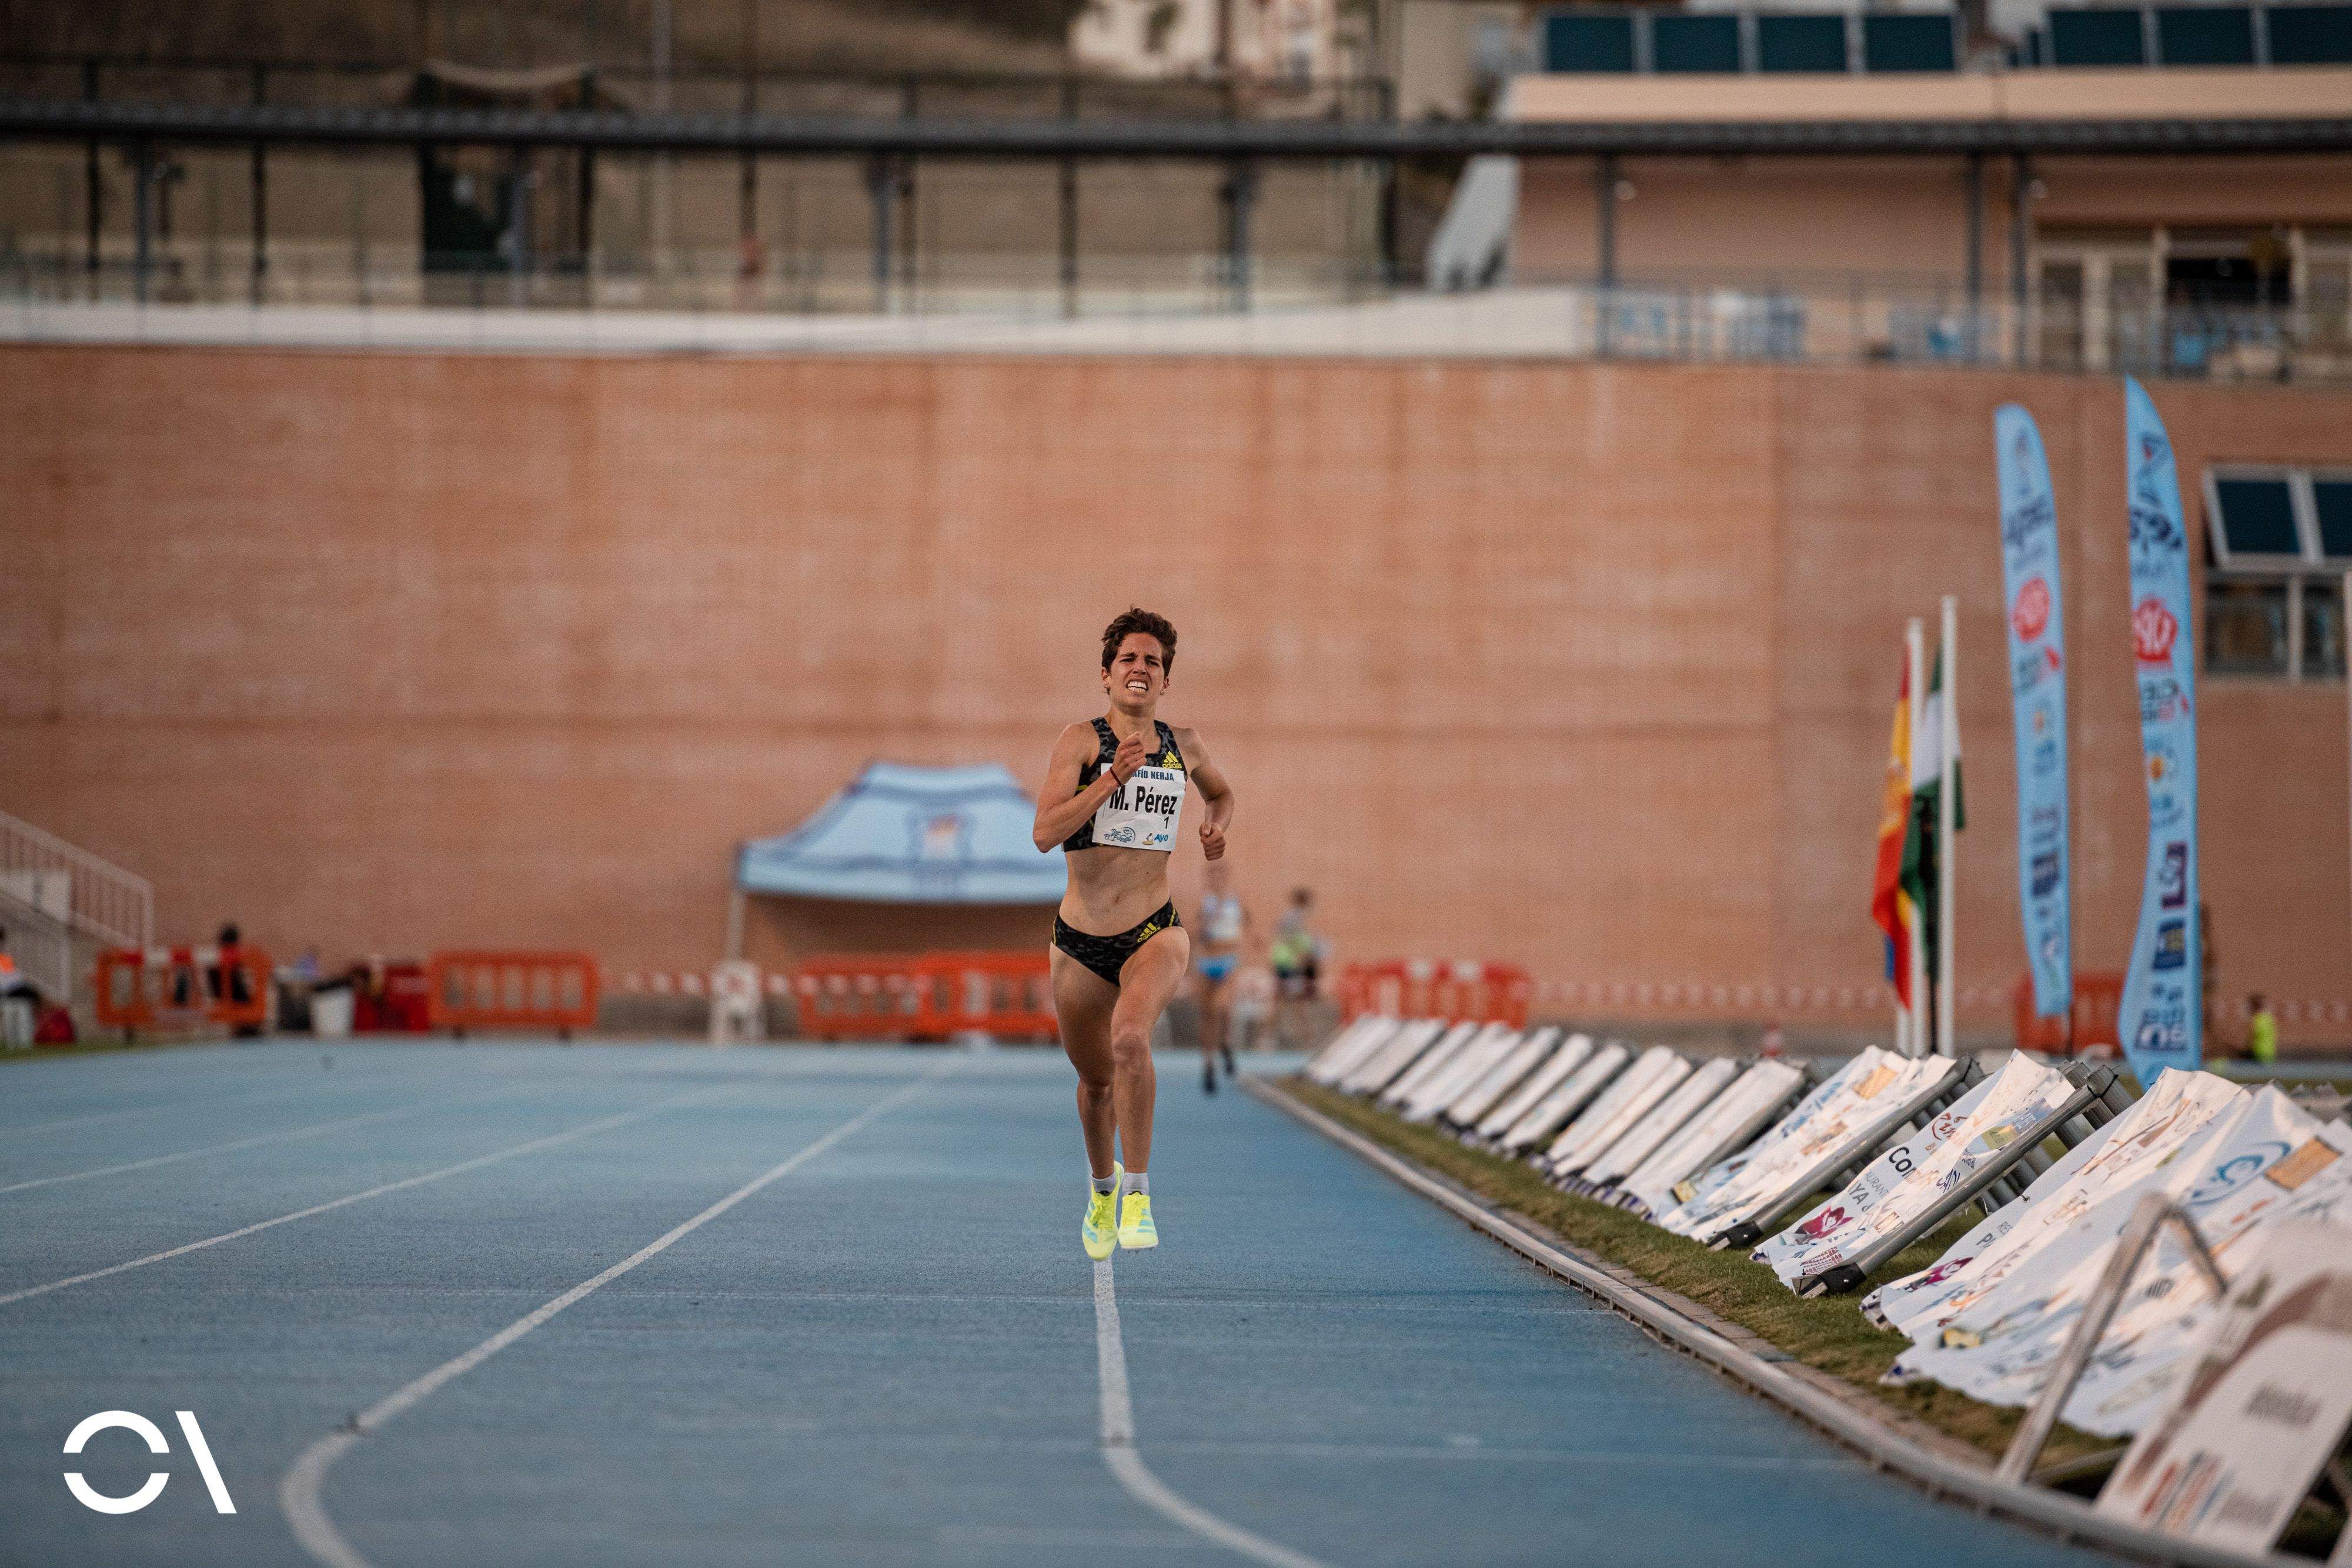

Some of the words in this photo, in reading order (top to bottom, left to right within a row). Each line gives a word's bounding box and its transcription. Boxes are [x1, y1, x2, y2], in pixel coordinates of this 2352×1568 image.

[1133, 769, 1148, 778] AFÍO
[1151, 771, 1174, 781] NERJA
[1110, 785, 1129, 811] M.
[1135, 785, 1178, 815] Pérez
[1164, 816, 1170, 829] 1
